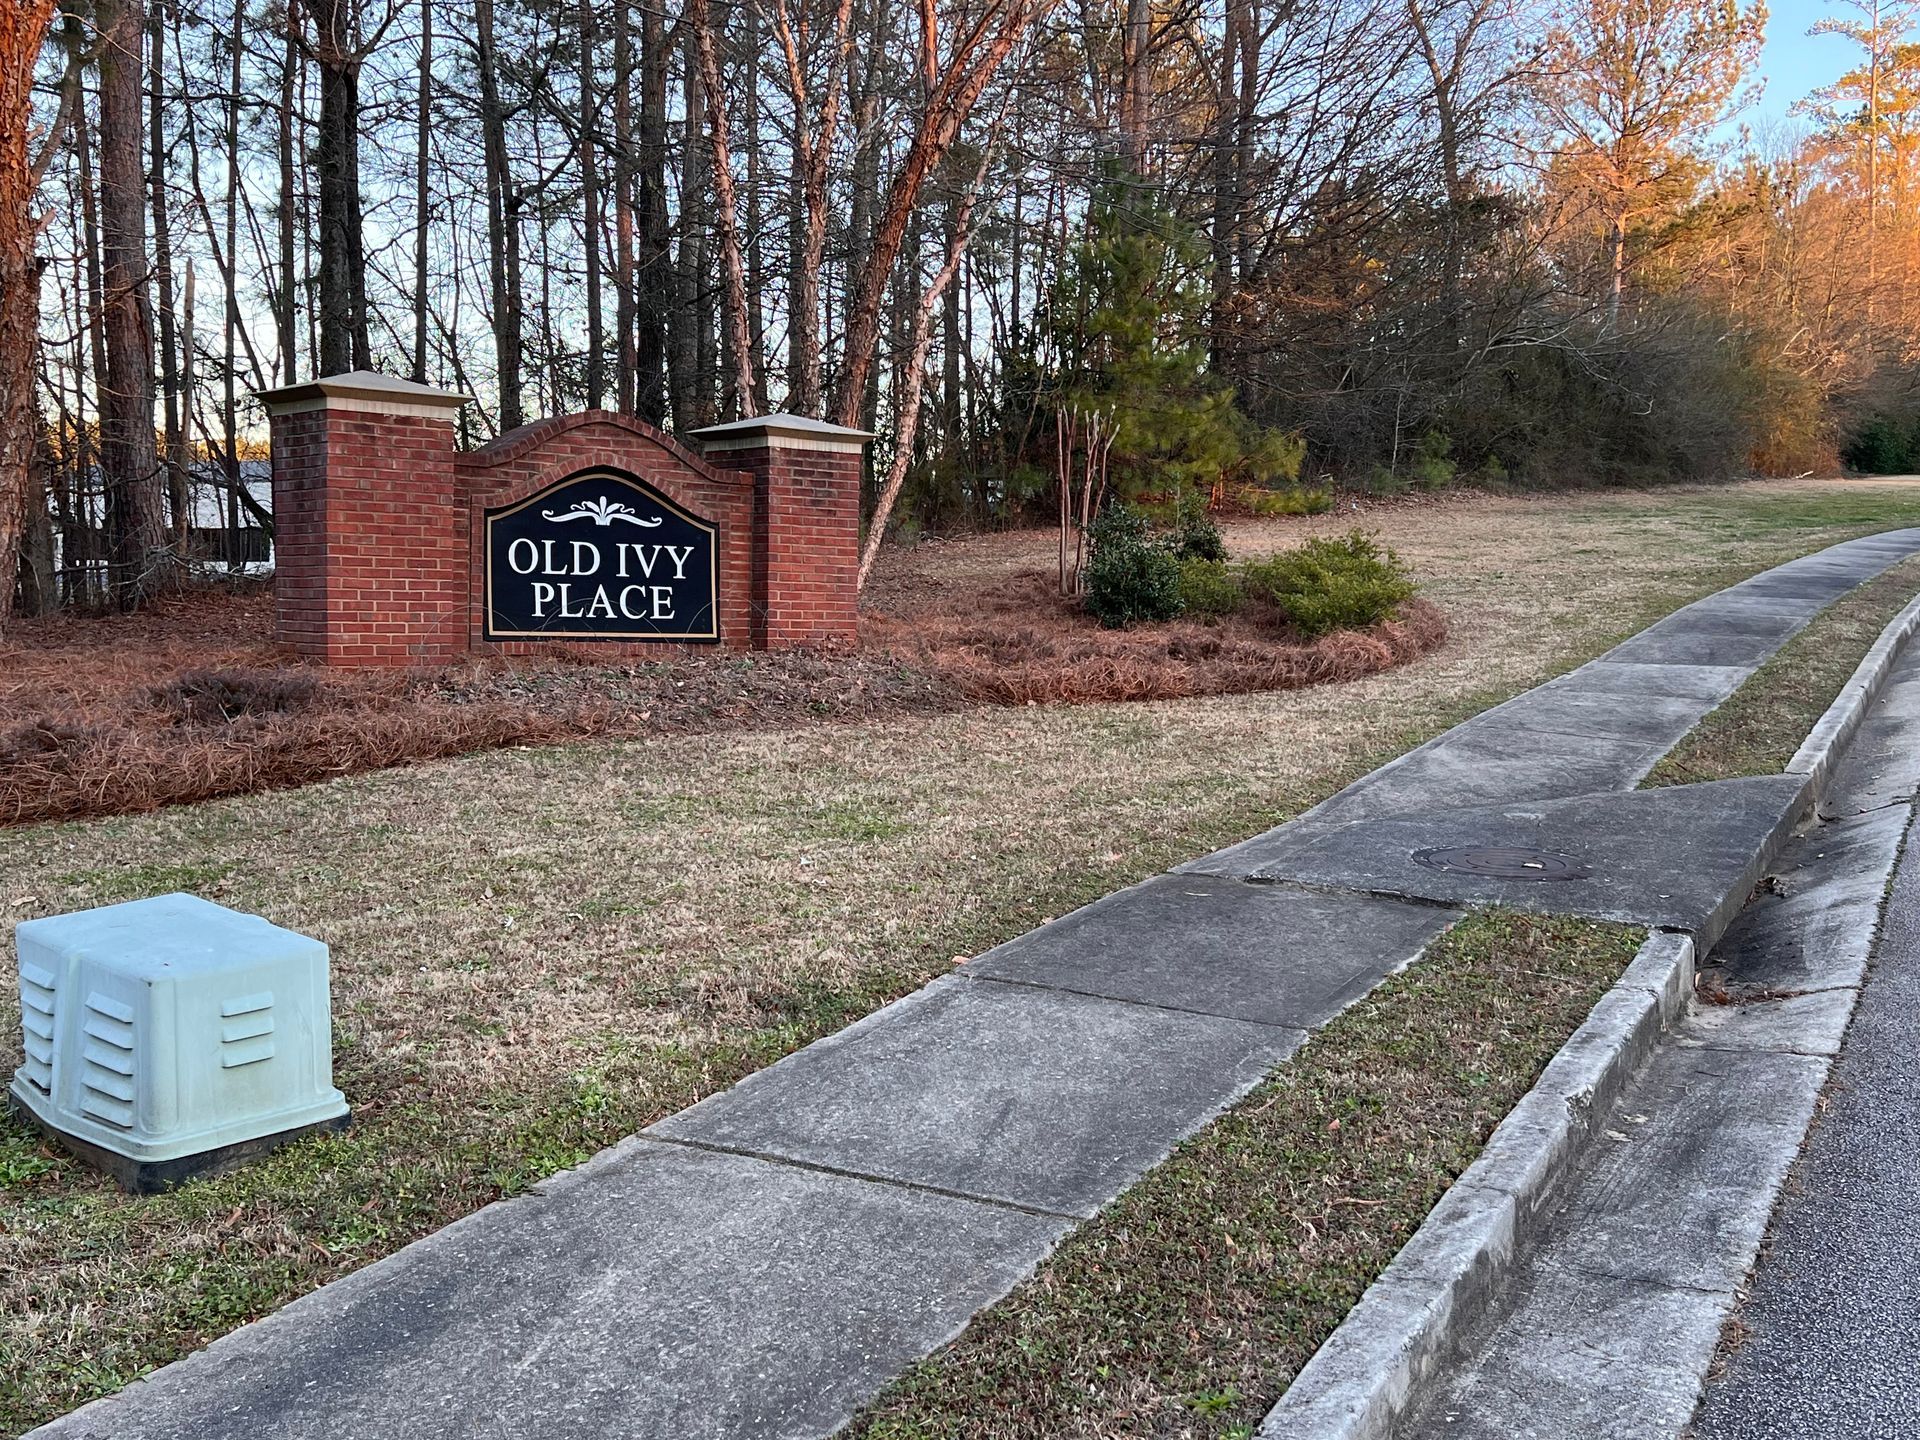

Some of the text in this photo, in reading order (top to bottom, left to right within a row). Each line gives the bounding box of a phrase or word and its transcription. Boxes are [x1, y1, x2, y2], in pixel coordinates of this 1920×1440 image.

[508, 538, 695, 579] OLD IVY
[530, 582, 676, 620] PLACE
